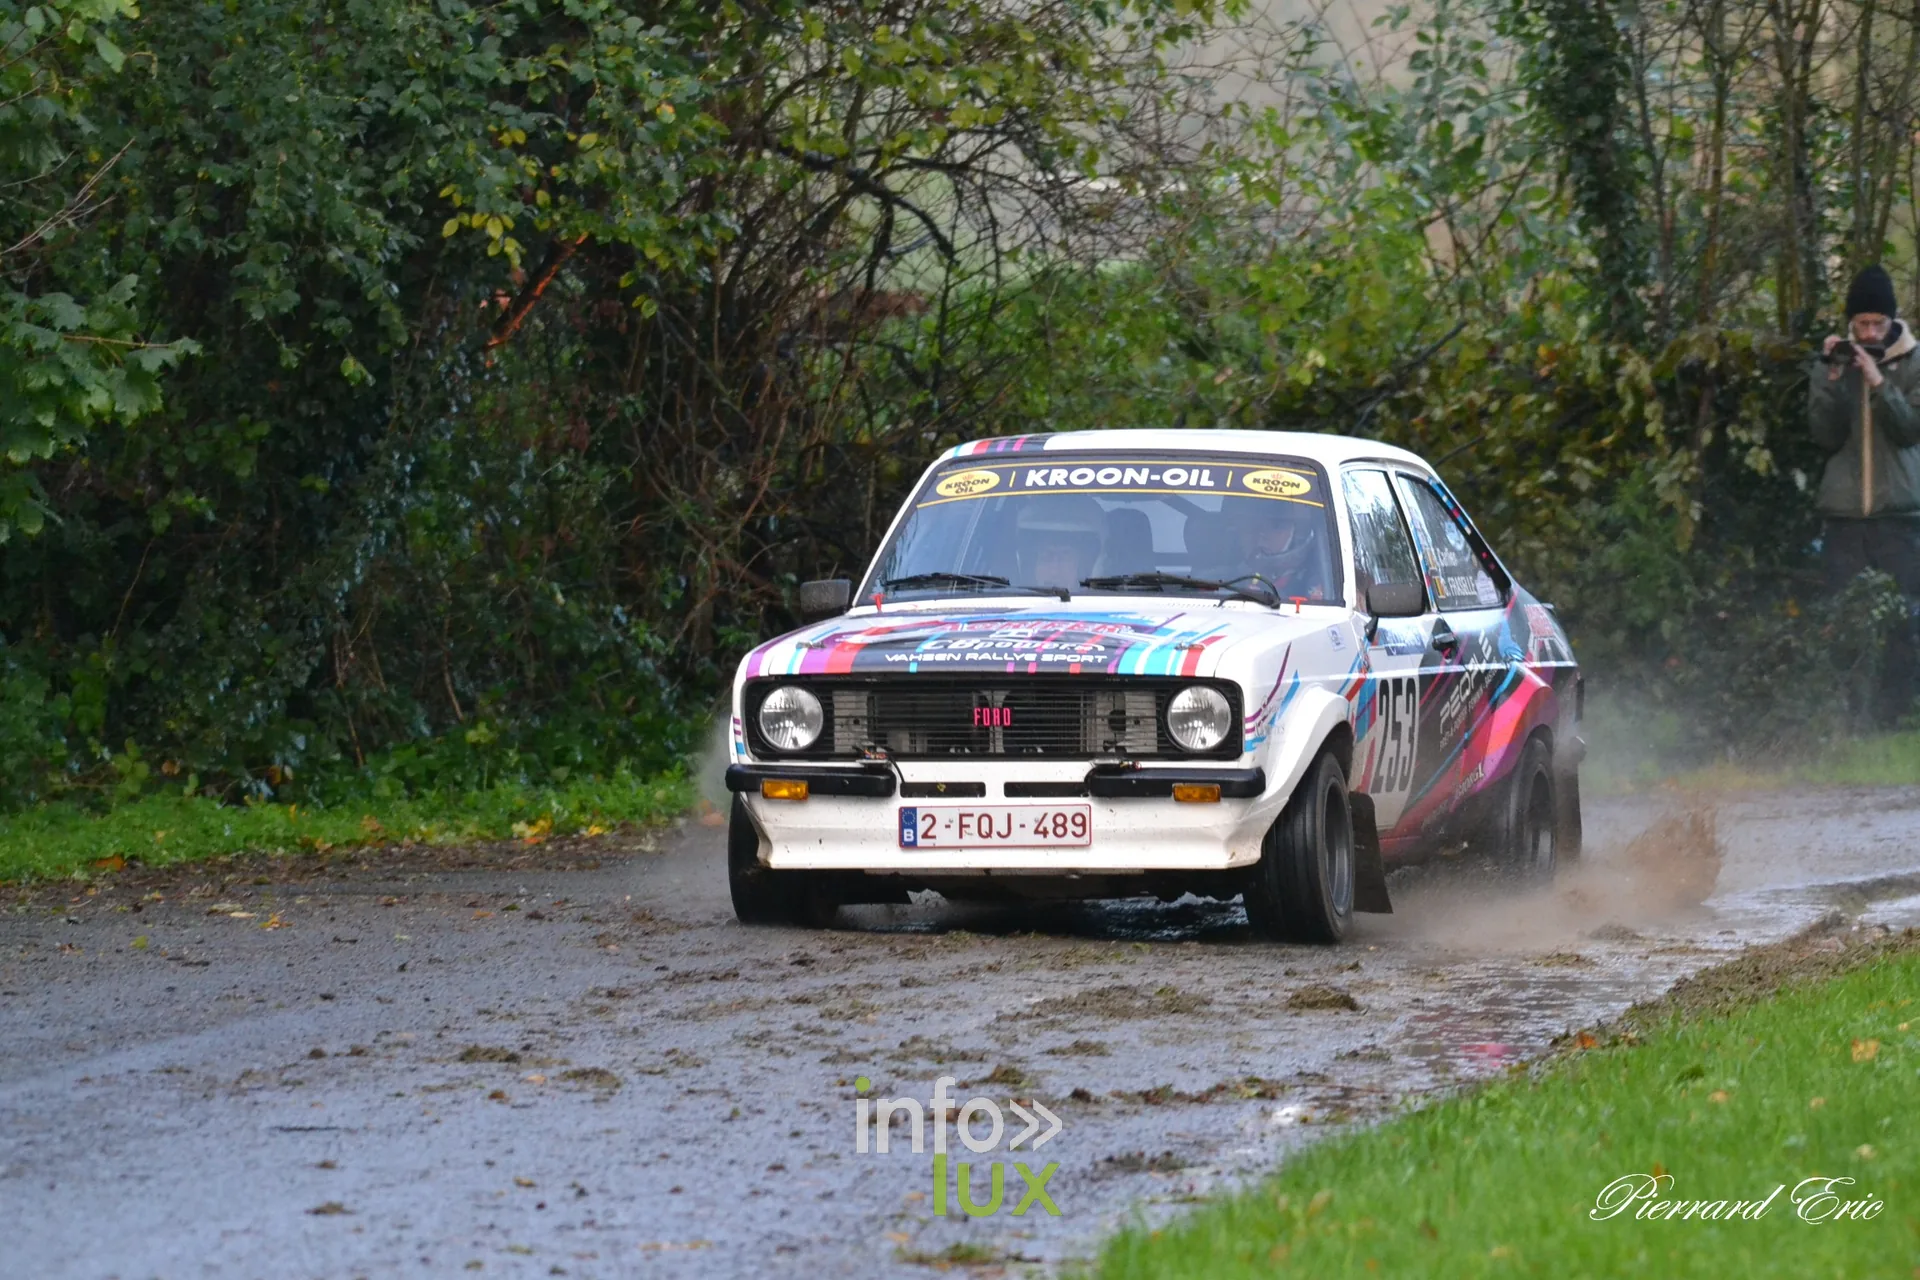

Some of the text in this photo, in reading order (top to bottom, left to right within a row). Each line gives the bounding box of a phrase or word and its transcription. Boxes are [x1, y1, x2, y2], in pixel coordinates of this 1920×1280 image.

[1025, 467, 1215, 487] KROON-OIL
[1252, 477, 1301, 489] KROON
[945, 478, 990, 490] KROON
[955, 486, 975, 494] OIL
[1264, 485, 1285, 493] OIL
[885, 652, 1108, 663] VAHSEN RALLYE SPORT
[974, 707, 1011, 727] FORD
[1370, 677, 1417, 794] 253
[903, 829, 915, 842] B
